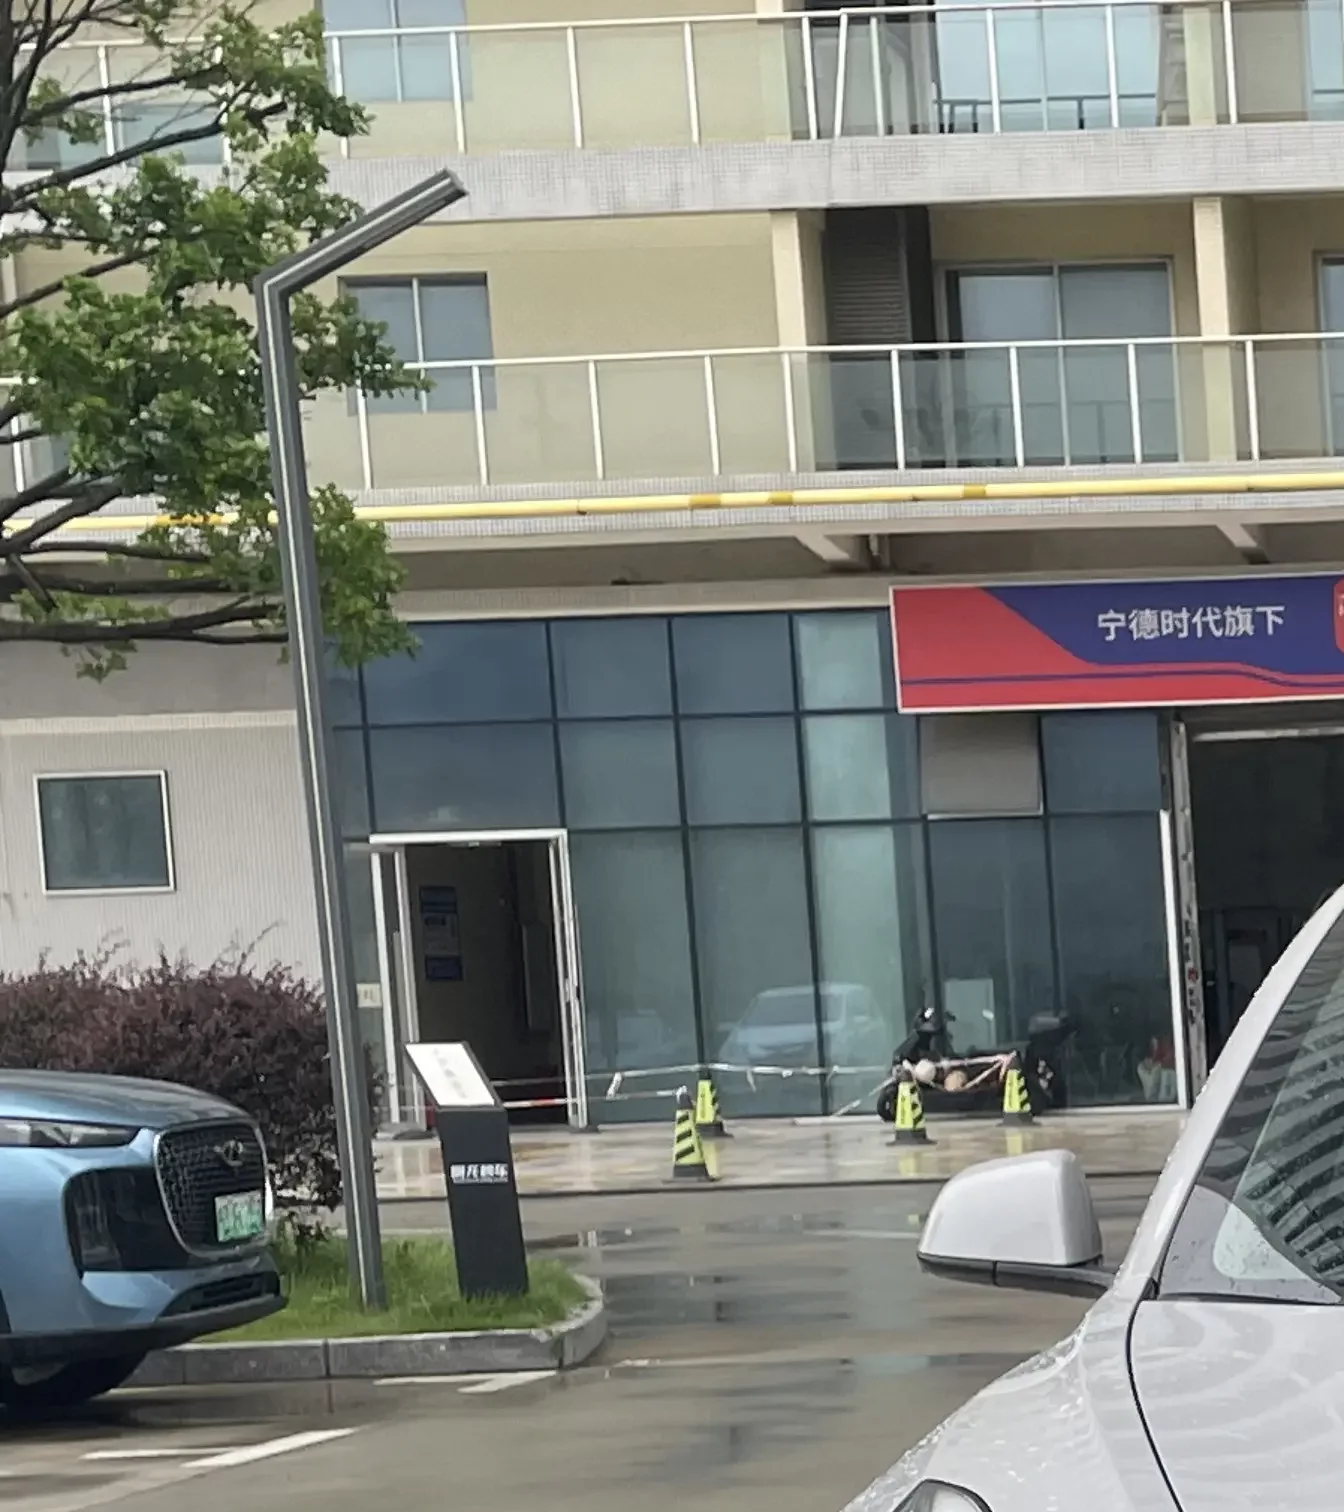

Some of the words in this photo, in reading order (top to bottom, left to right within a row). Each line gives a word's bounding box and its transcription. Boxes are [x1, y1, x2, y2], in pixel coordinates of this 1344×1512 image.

[1098, 605, 1285, 641] 宁德时代旗下
